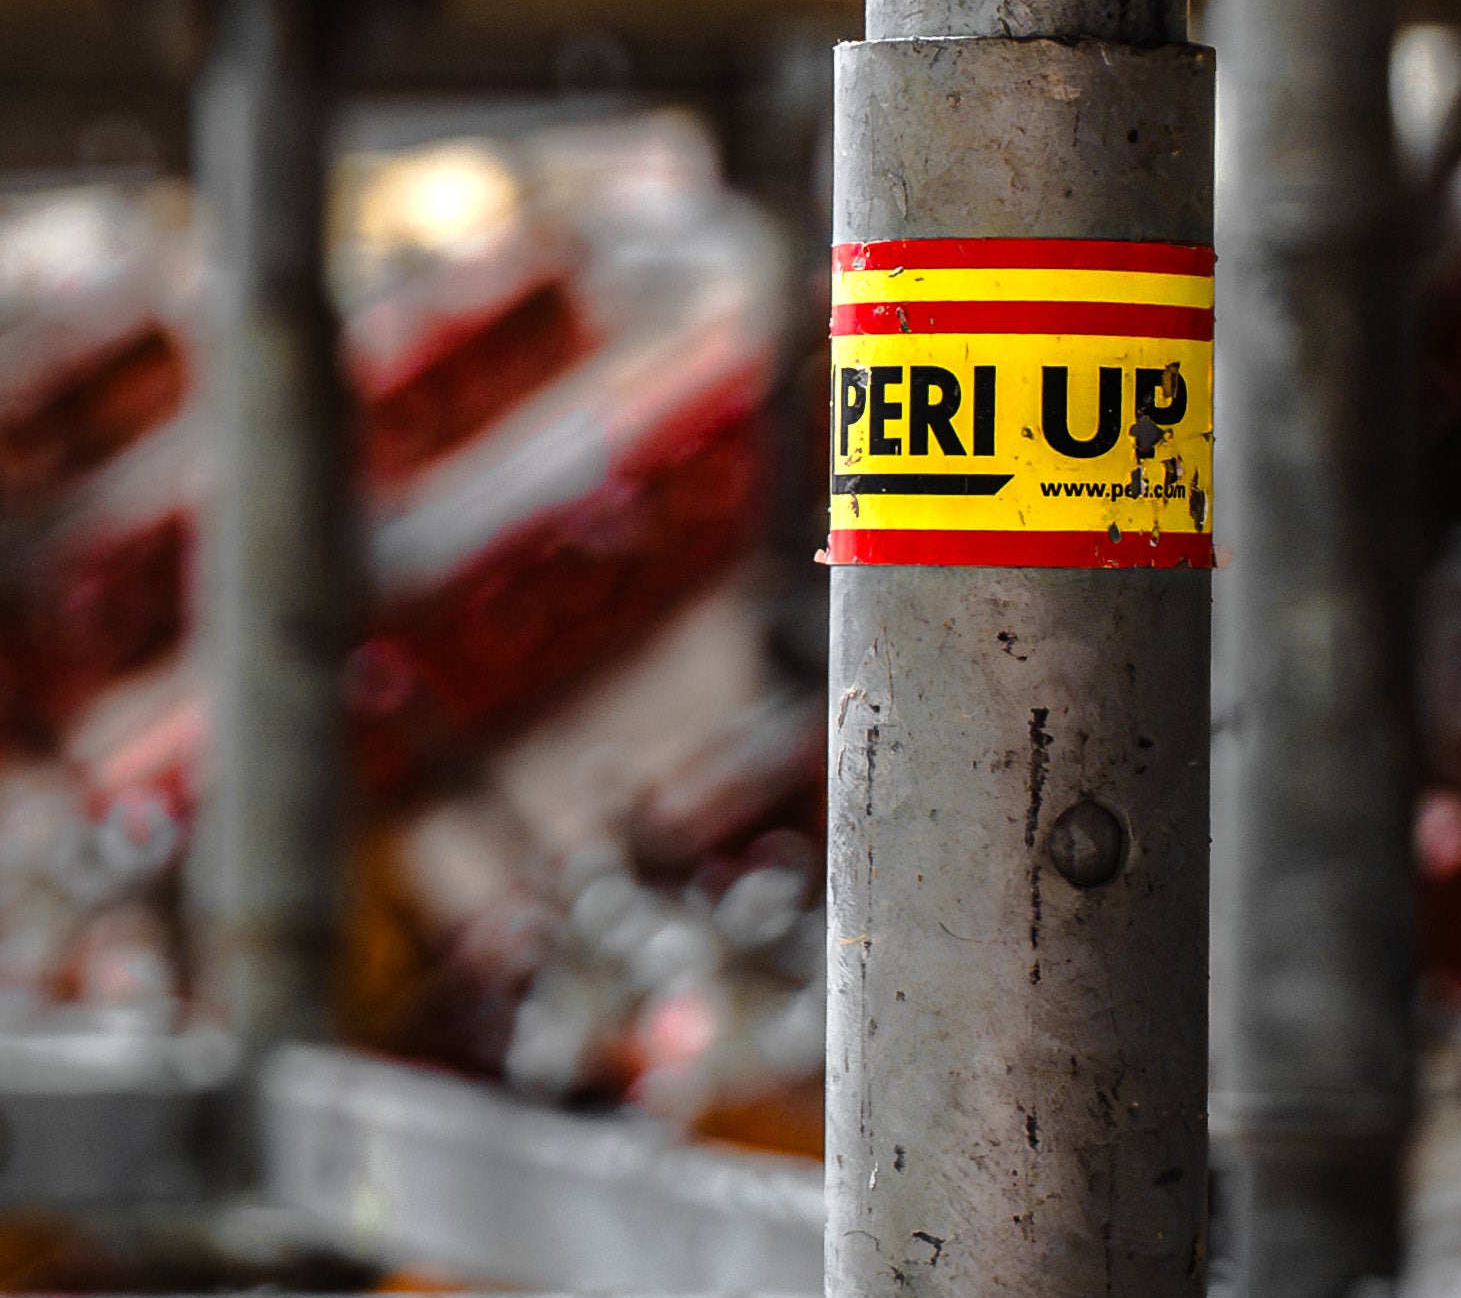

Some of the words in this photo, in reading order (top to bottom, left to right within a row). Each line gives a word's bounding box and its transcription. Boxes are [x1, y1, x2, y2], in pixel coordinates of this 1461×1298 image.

[839, 364, 997, 456] PERI
[1041, 365, 1188, 459] UP
[1040, 480, 1186, 502] www.pei.com
